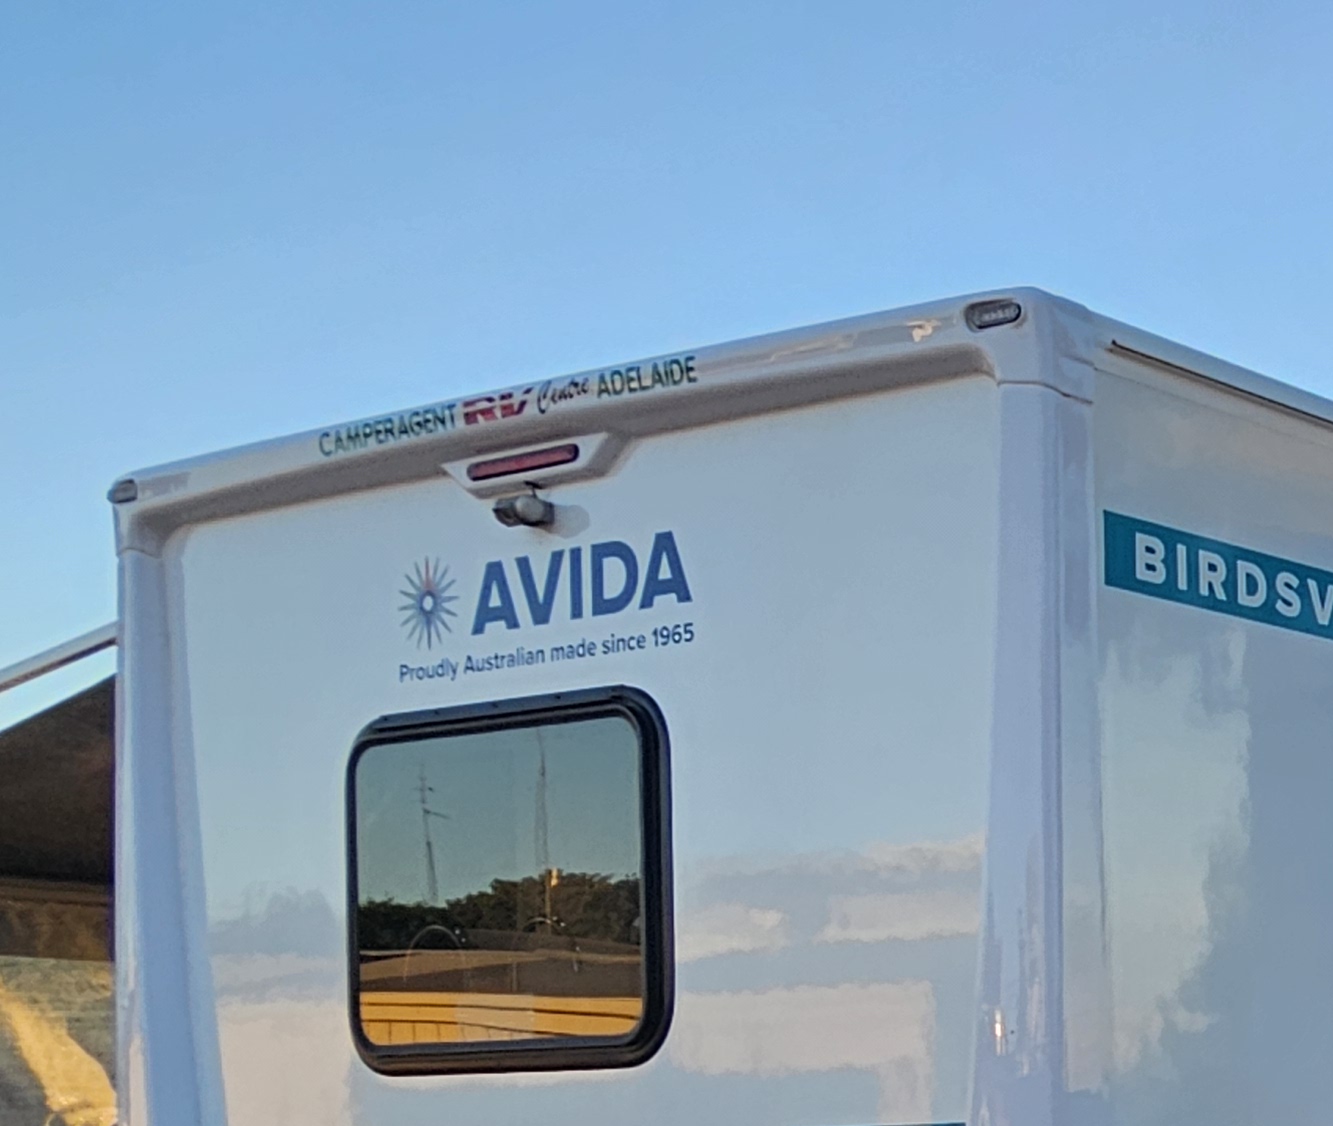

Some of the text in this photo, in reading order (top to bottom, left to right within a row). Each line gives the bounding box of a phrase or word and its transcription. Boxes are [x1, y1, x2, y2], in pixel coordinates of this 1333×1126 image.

[597, 355, 698, 398] ADELAIDE
[470, 530, 693, 636] AVIDA
[399, 622, 695, 683] Proudly Australian made since 1965
